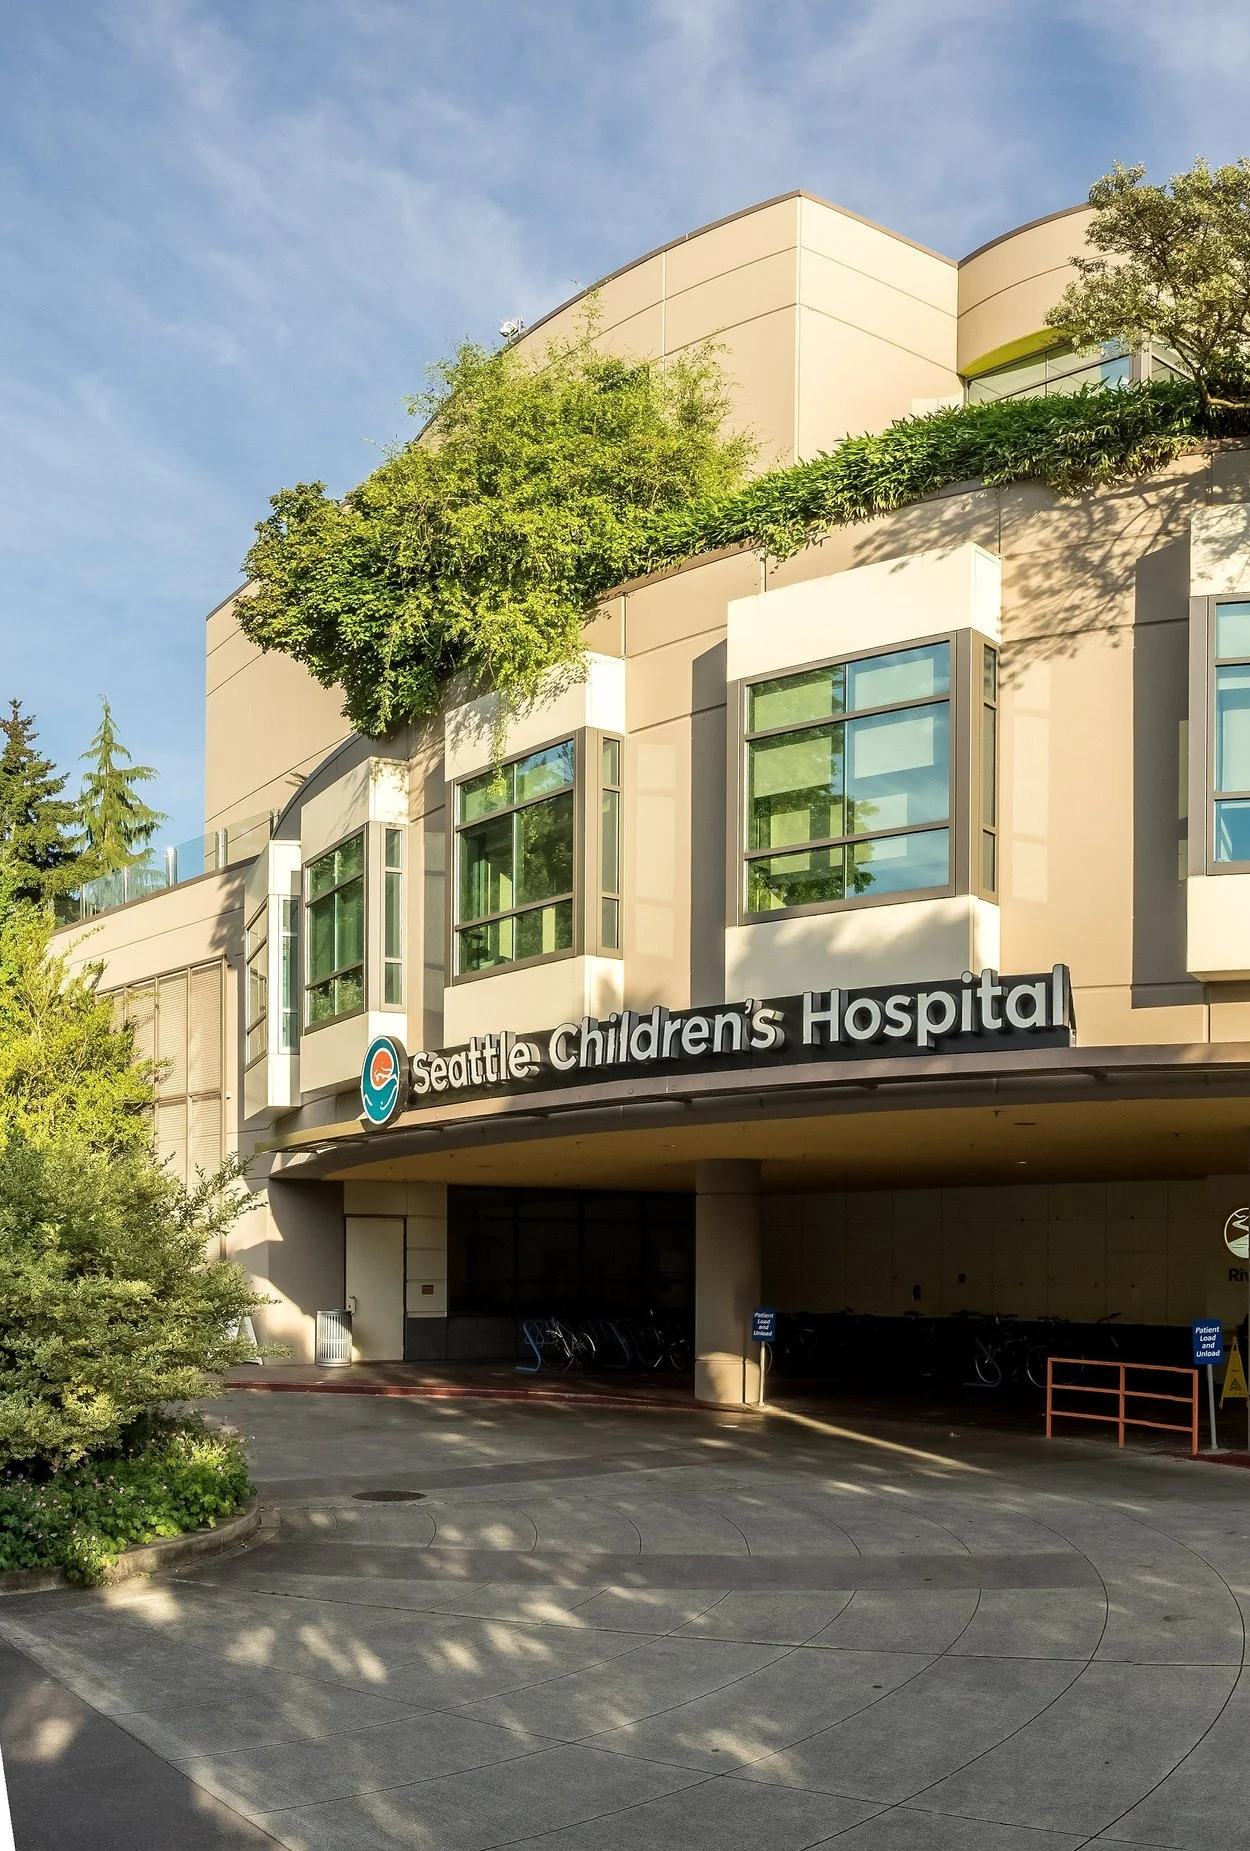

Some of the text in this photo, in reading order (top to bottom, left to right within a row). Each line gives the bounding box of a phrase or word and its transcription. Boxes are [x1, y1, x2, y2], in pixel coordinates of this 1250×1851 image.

[412, 964, 1068, 1094] Seattle Children's Hospital
[1195, 1326, 1220, 1334] Patient
[1199, 1334, 1217, 1342] Load
[1201, 1341, 1216, 1349] and
[1195, 1349, 1221, 1357] Unload
